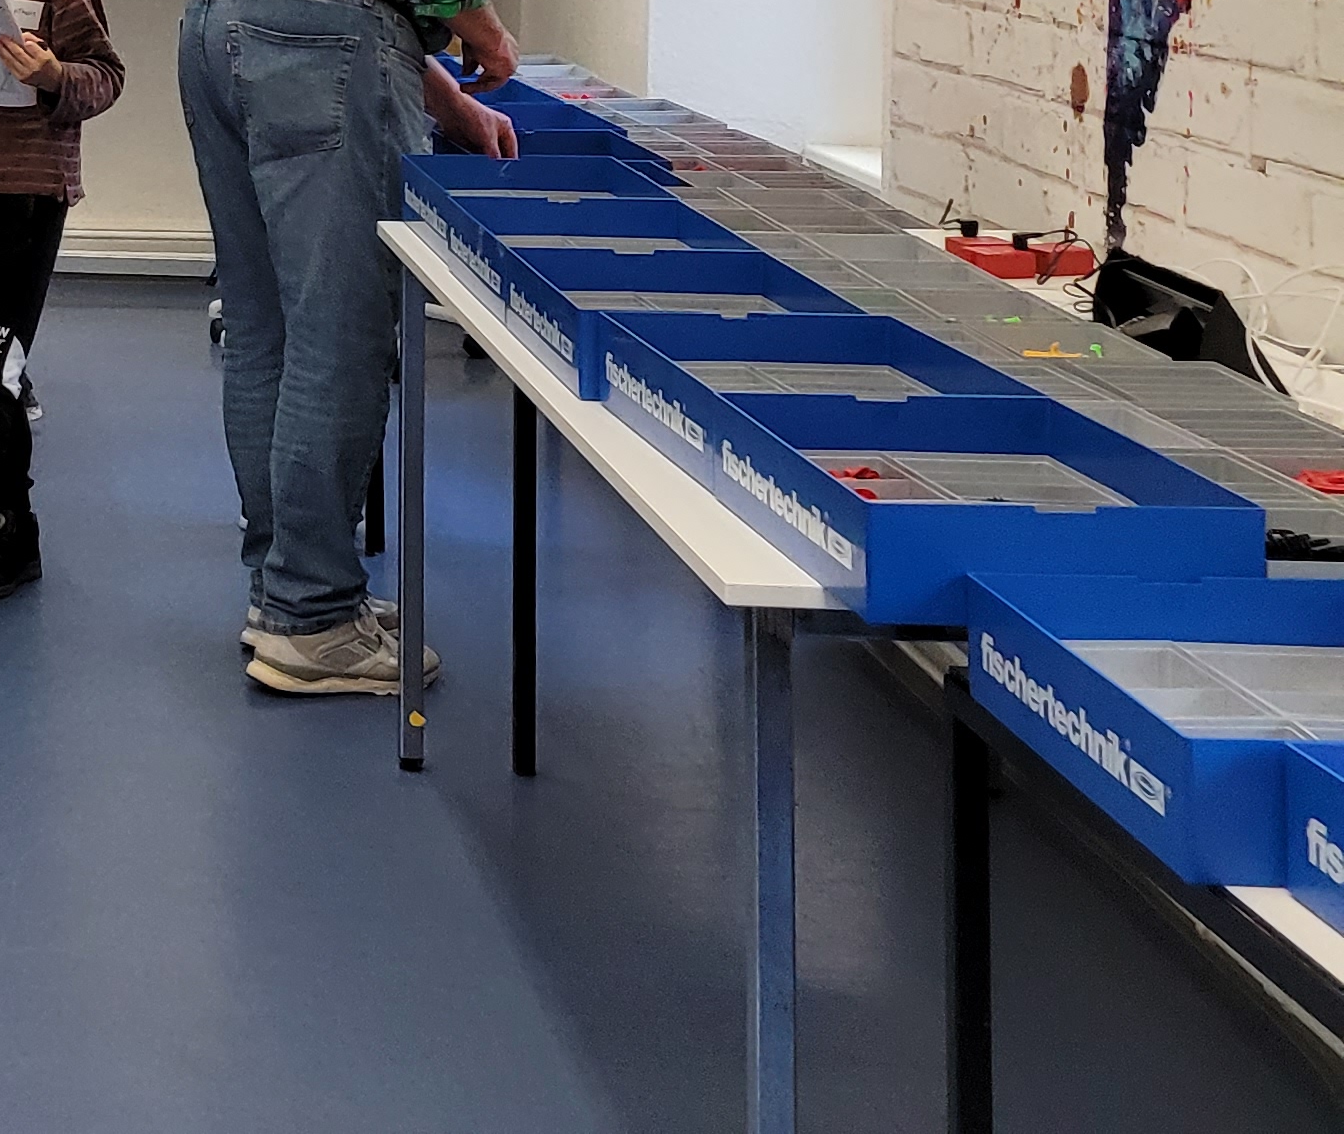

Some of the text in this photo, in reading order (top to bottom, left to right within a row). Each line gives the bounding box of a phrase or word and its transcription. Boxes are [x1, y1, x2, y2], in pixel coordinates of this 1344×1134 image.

[605, 351, 686, 440] fischertechnik
[721, 439, 828, 553] fischertechnik
[980, 632, 1131, 789] fischertechnik
